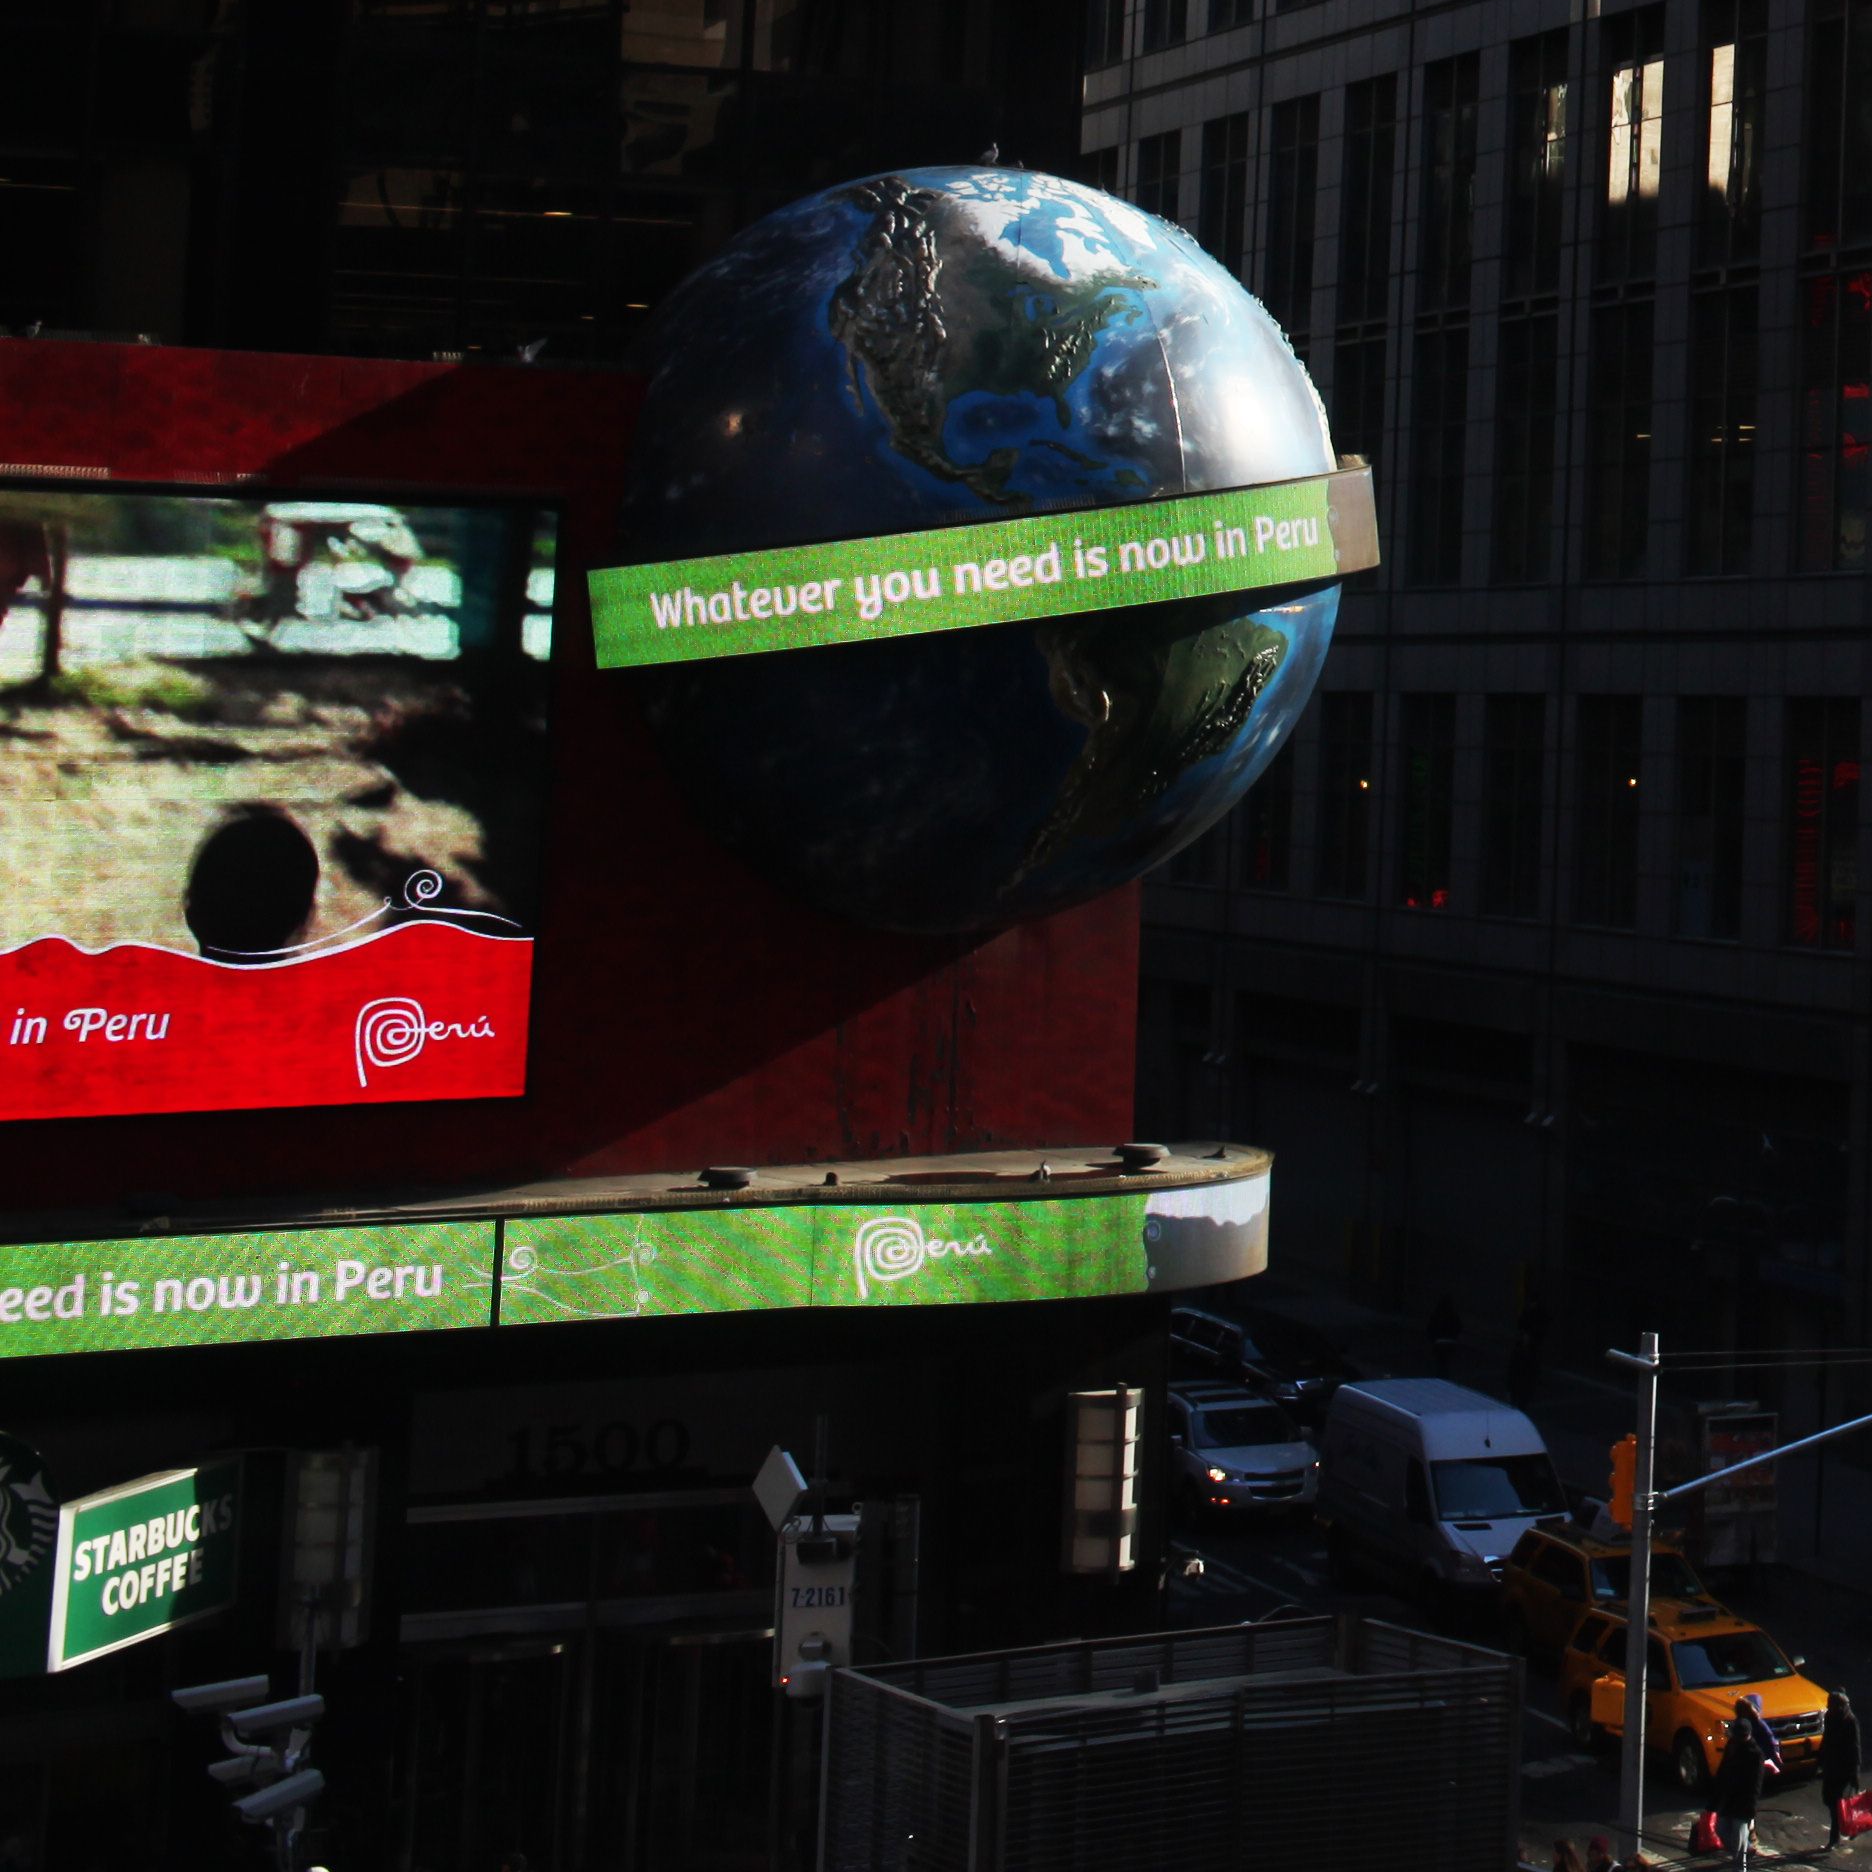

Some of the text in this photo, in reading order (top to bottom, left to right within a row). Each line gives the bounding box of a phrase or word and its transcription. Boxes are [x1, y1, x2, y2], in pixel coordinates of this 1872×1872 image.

[651, 515, 1319, 630] Whatever you need is now in Peru
[9, 1004, 171, 1047] in Peru
[100, 1271, 140, 1317] is
[153, 1274, 262, 1314] now
[276, 1261, 321, 1306] in
[334, 1259, 444, 1303] Peru
[505, 1419, 693, 1481] 1500
[73, 1490, 235, 1584] STARBUCKS
[101, 1547, 204, 1617] COFFEE
[790, 1585, 847, 1609] 7-2161
